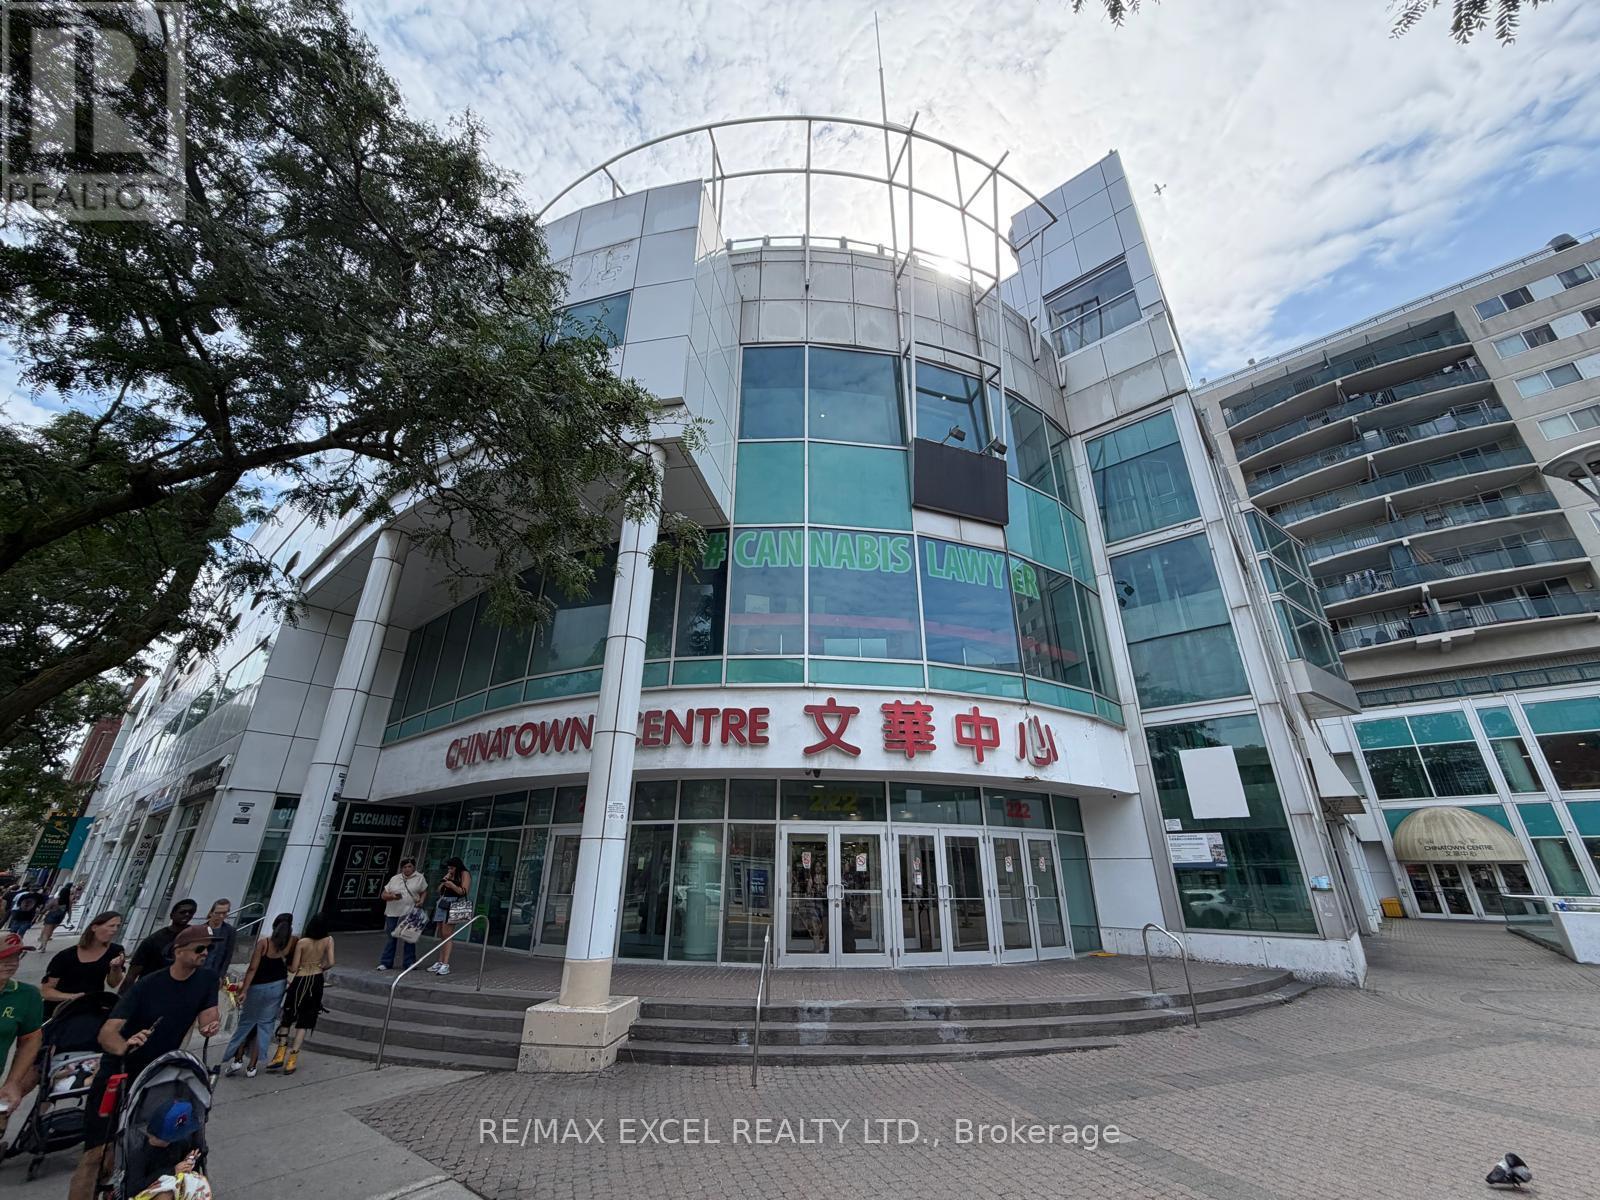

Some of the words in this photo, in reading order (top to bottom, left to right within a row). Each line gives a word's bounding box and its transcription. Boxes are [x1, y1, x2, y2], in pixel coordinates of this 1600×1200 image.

[927, 541, 1040, 600] LAWYER
[446, 714, 595, 769] CHINATOWN
[635, 707, 770, 746] ENTRE
[803, 697, 1059, 767] 文華中心
[352, 812, 405, 827] EXCHANGE
[1006, 800, 1031, 819] 222
